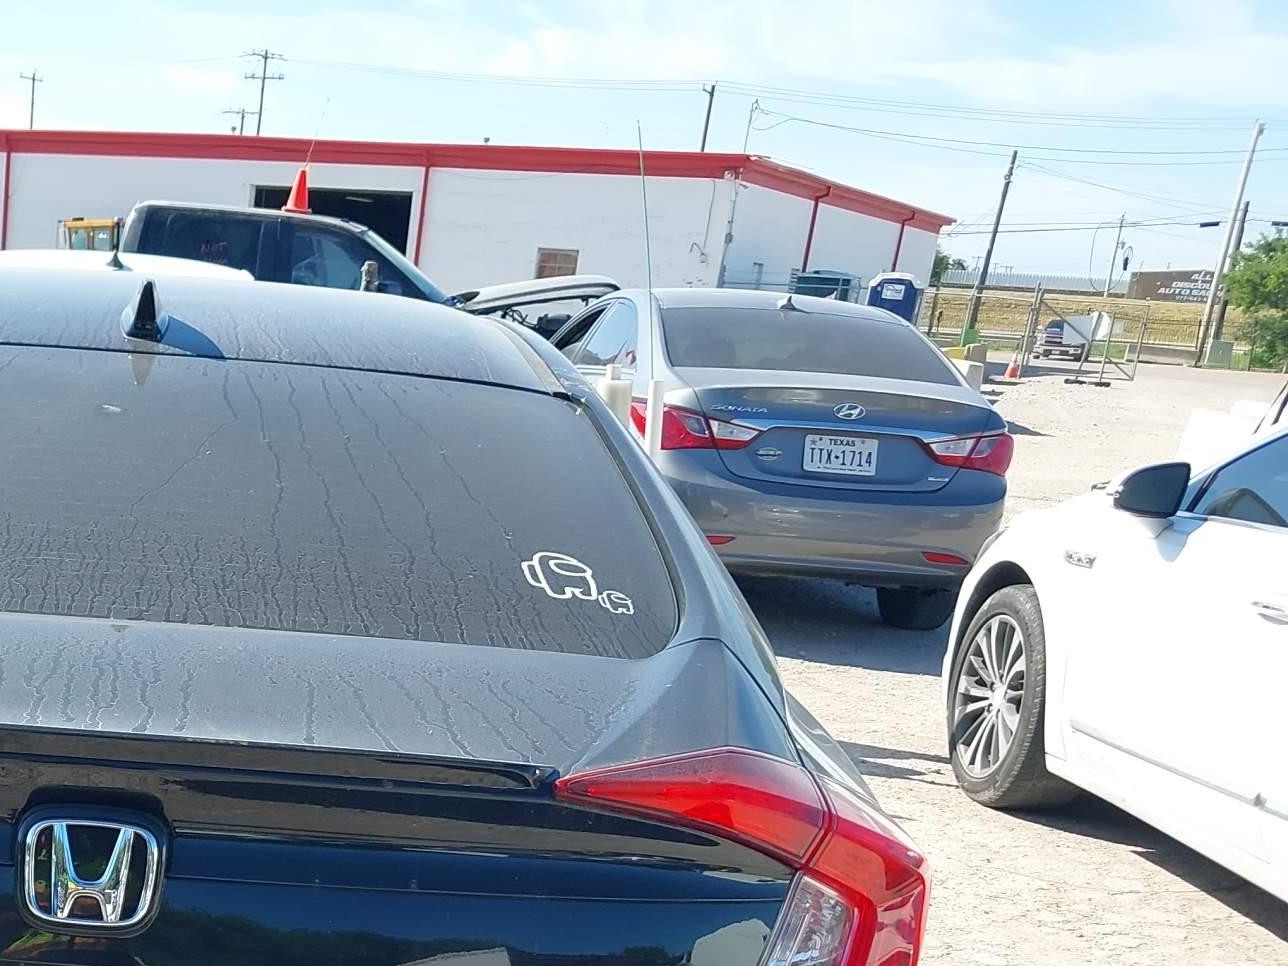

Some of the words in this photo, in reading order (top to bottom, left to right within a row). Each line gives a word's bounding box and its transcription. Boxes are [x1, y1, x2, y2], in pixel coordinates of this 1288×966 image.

[1157, 287, 1189, 296] AUTO
[710, 403, 768, 414] SONATA
[828, 438, 856, 447] TEXAS
